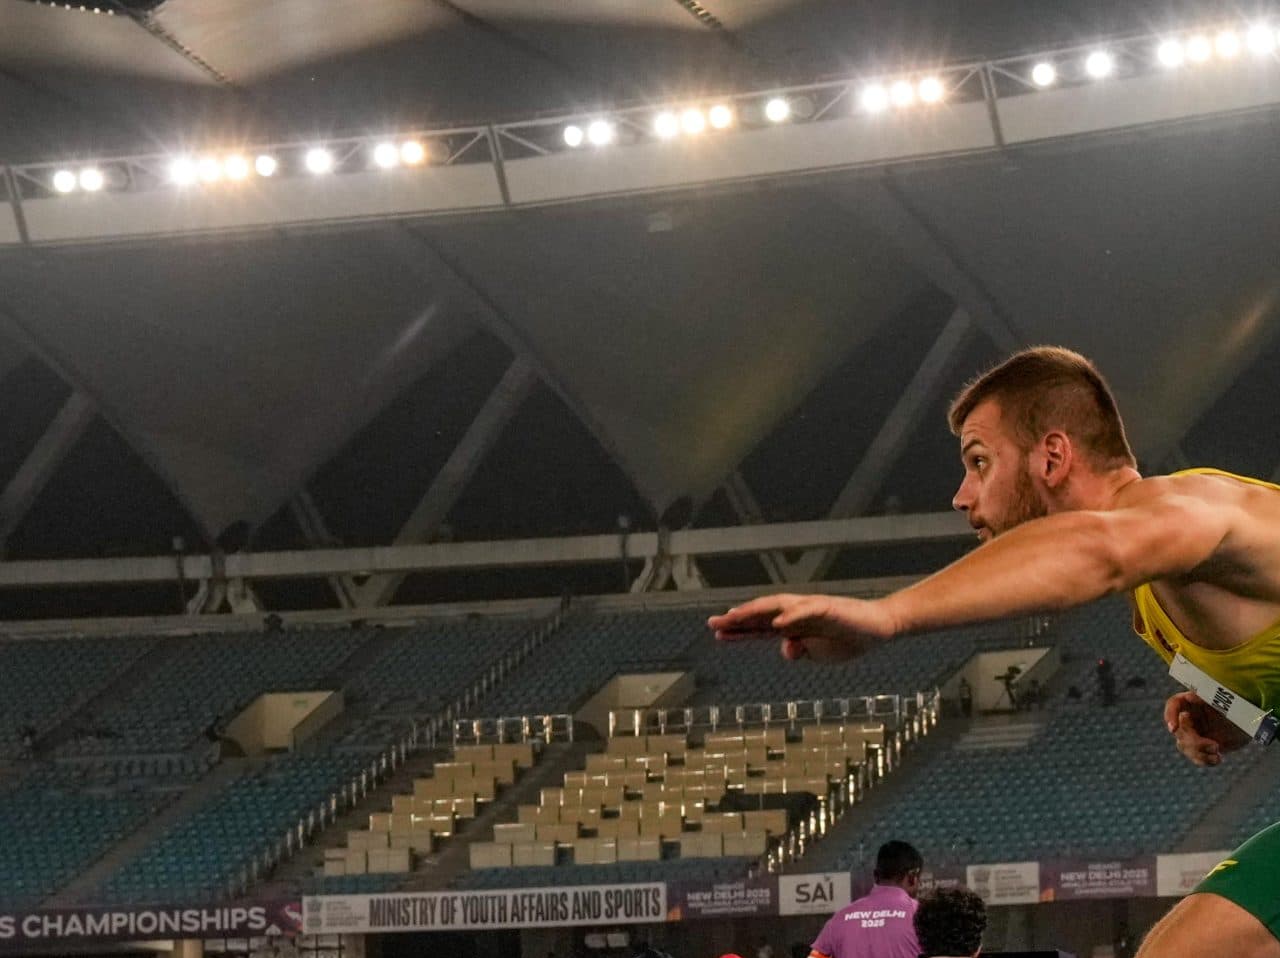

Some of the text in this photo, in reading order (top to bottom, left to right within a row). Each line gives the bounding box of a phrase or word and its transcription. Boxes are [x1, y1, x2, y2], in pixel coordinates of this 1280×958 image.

[1060, 871, 1086, 881] NEW
[687, 891, 712, 901] NEW
[795, 879, 834, 904] SAI
[369, 896, 438, 928] MINISTRY
[440, 895, 460, 926] OF
[461, 893, 507, 924] YOUTH
[511, 891, 568, 922] AFFAIRS
[572, 890, 602, 921] AND
[604, 887, 662, 919] SPORTS
[844, 910, 906, 921] NEW DELHI
[22, 907, 267, 938] CHAMPIONSHIPS
[861, 919, 886, 928] 2025
